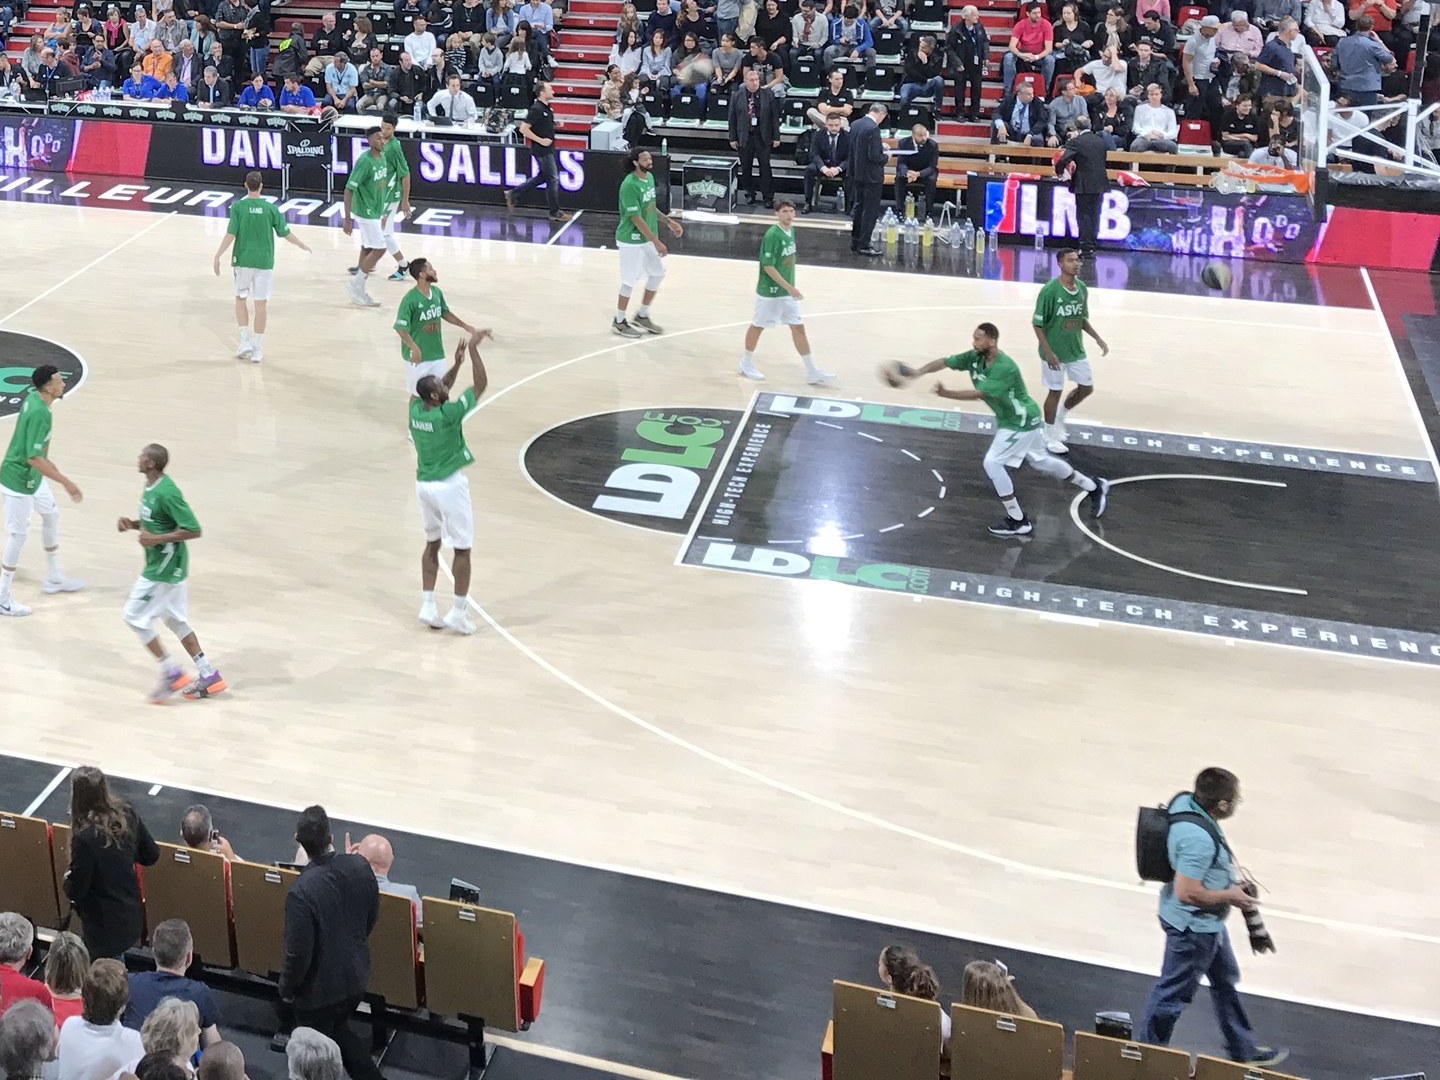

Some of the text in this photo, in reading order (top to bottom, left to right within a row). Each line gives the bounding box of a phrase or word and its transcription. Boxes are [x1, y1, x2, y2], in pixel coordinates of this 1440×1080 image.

[286, 145, 325, 157] SPALDING
[419, 140, 585, 192] SALLS
[688, 179, 726, 198] ASVEL
[592, 420, 725, 520] LDLC
[711, 422, 772, 526] HIGH-TECH EXPERIENCE
[1189, 442, 1417, 476] EXPERIENCE
[702, 542, 910, 591] LDLC
[950, 580, 1173, 622] HIGH-TECH
